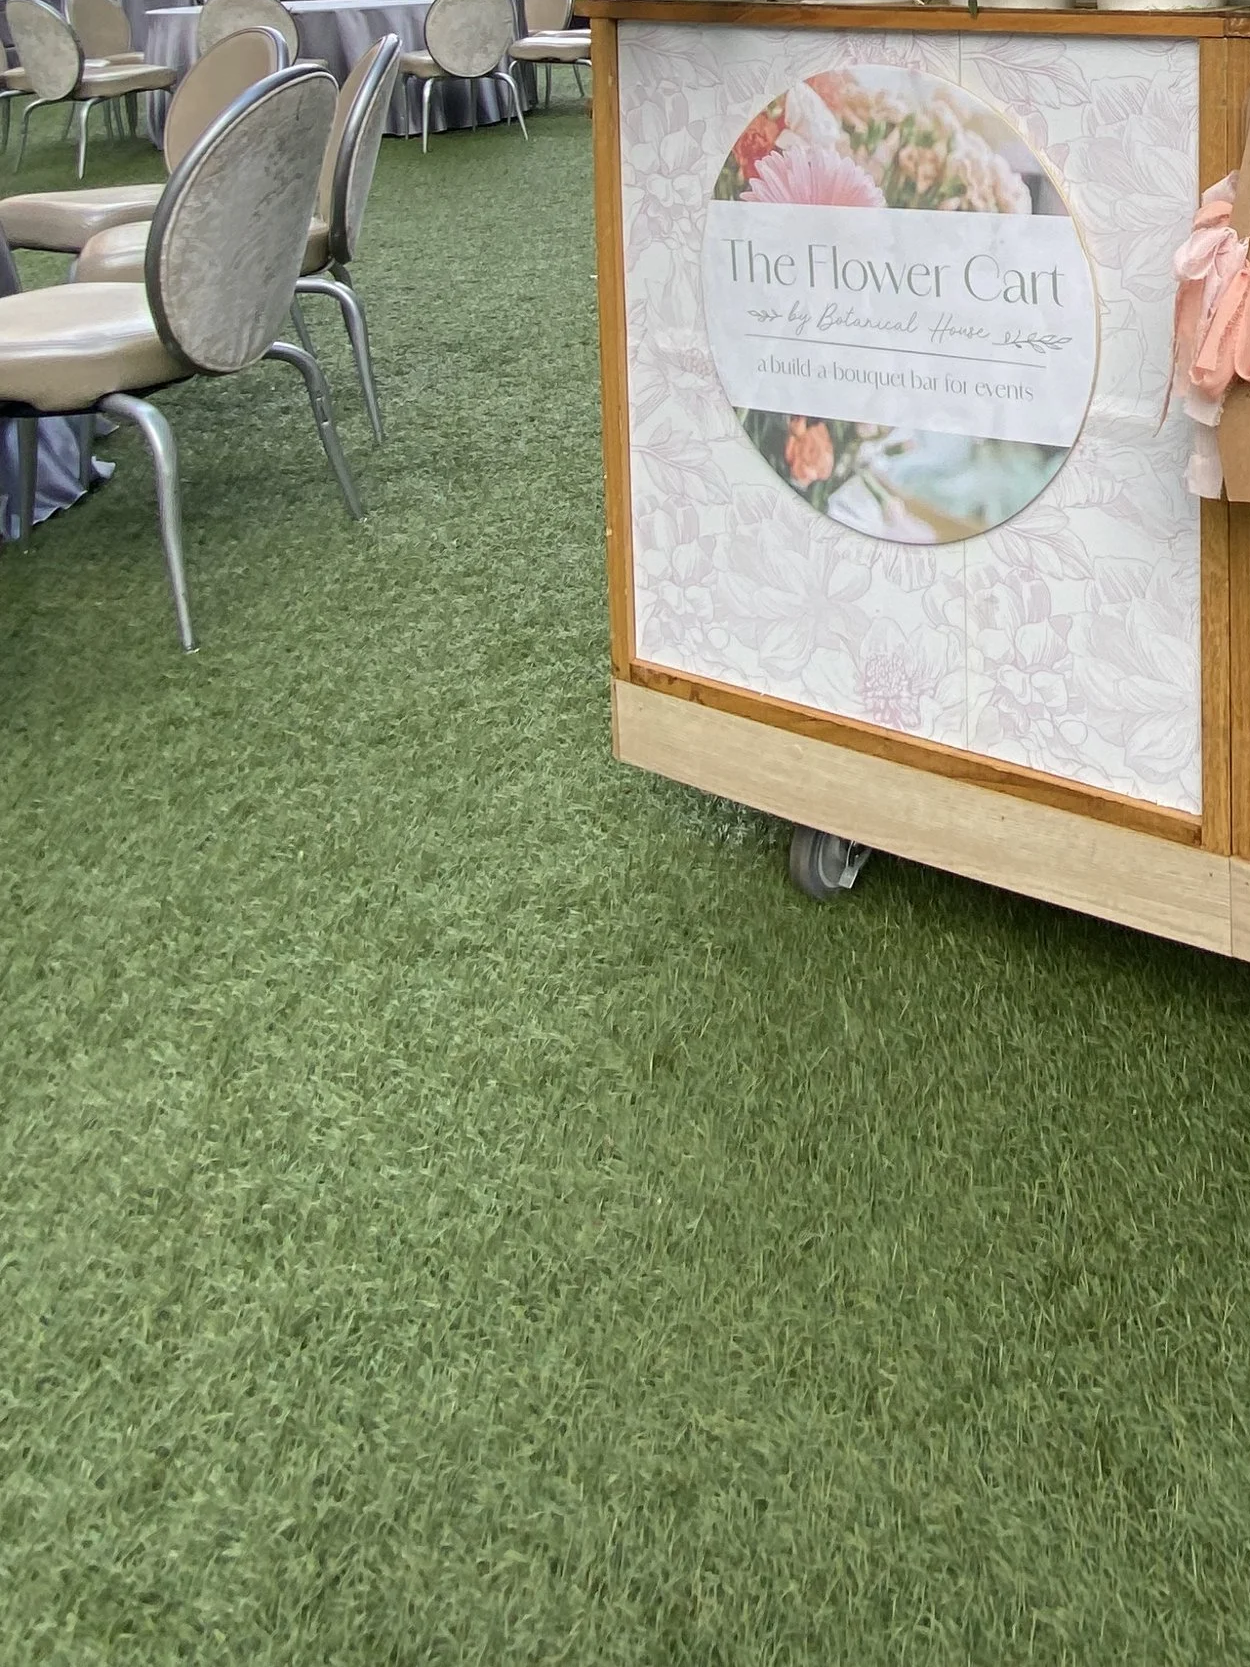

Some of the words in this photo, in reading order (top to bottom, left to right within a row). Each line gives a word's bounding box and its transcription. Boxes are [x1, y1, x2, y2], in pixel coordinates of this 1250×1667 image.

[721, 238, 797, 286] The
[807, 243, 951, 298] Flower
[963, 253, 1065, 308] Cart
[787, 300, 811, 336] by
[816, 302, 920, 333] Botanical
[928, 311, 990, 344] House
[910, 369, 939, 392] bar
[945, 373, 967, 395] for
[974, 379, 1034, 401] events
